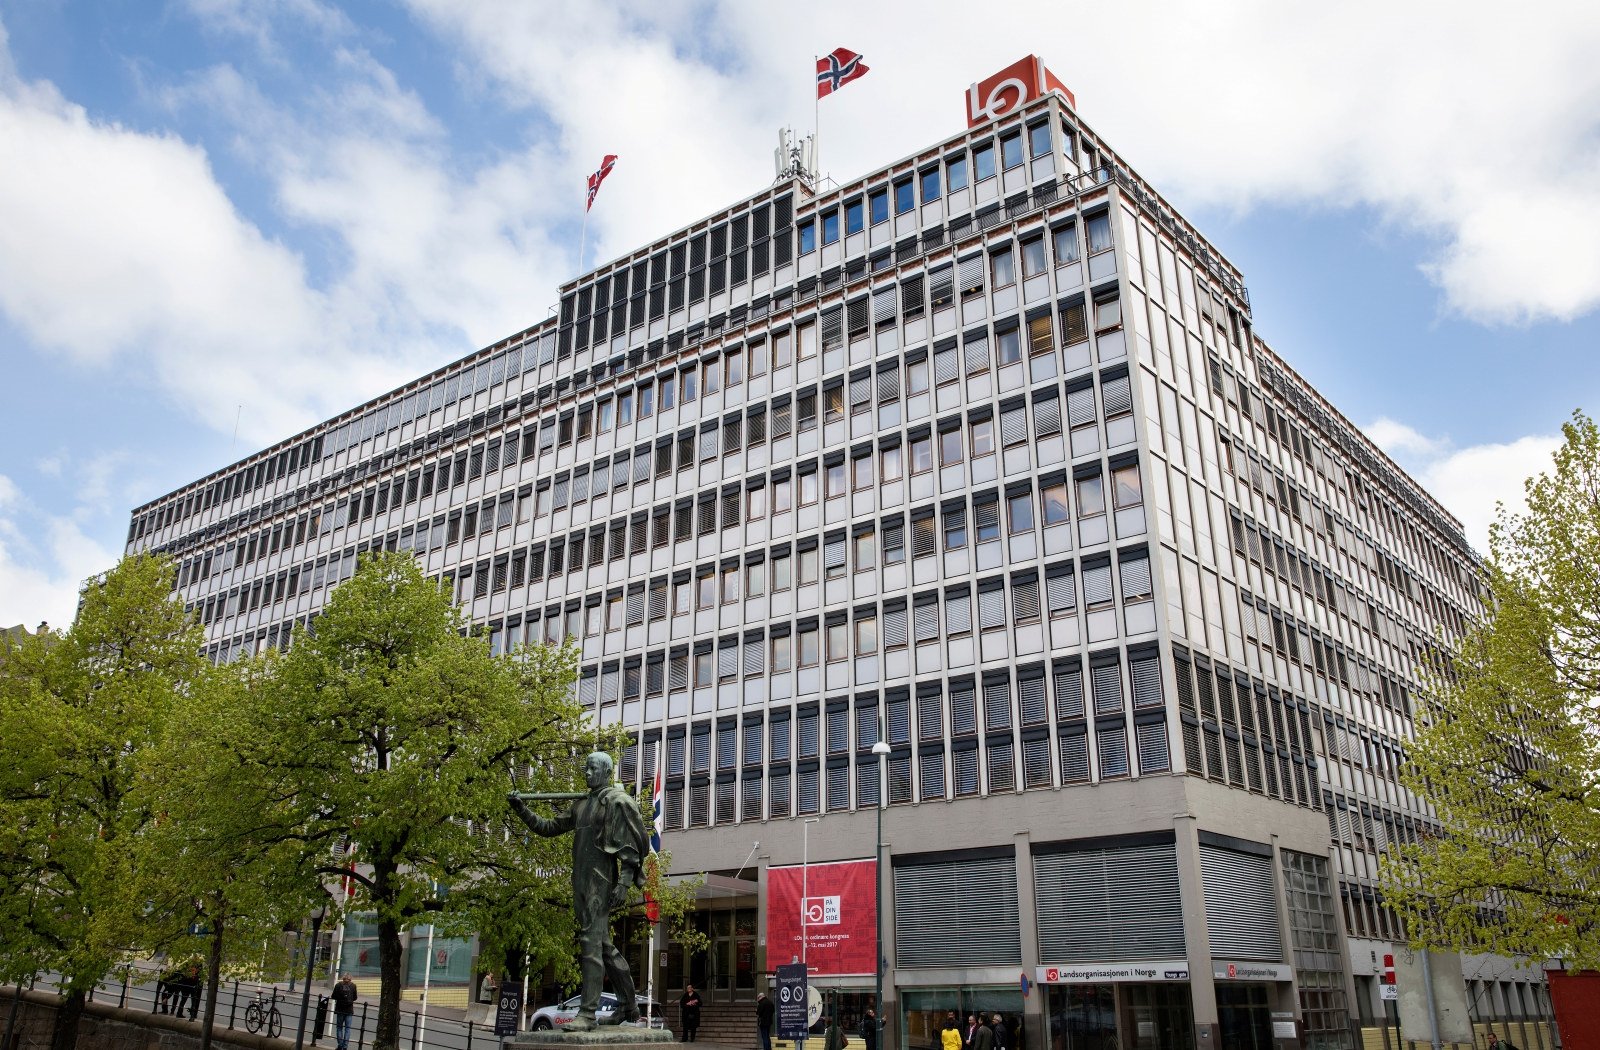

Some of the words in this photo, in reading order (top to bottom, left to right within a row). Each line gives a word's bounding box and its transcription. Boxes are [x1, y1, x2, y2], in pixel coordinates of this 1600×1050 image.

[970, 78, 1028, 121] LO
[1060, 970, 1128, 979] Landsorganisasjonen
[1135, 969, 1156, 978] Norge
